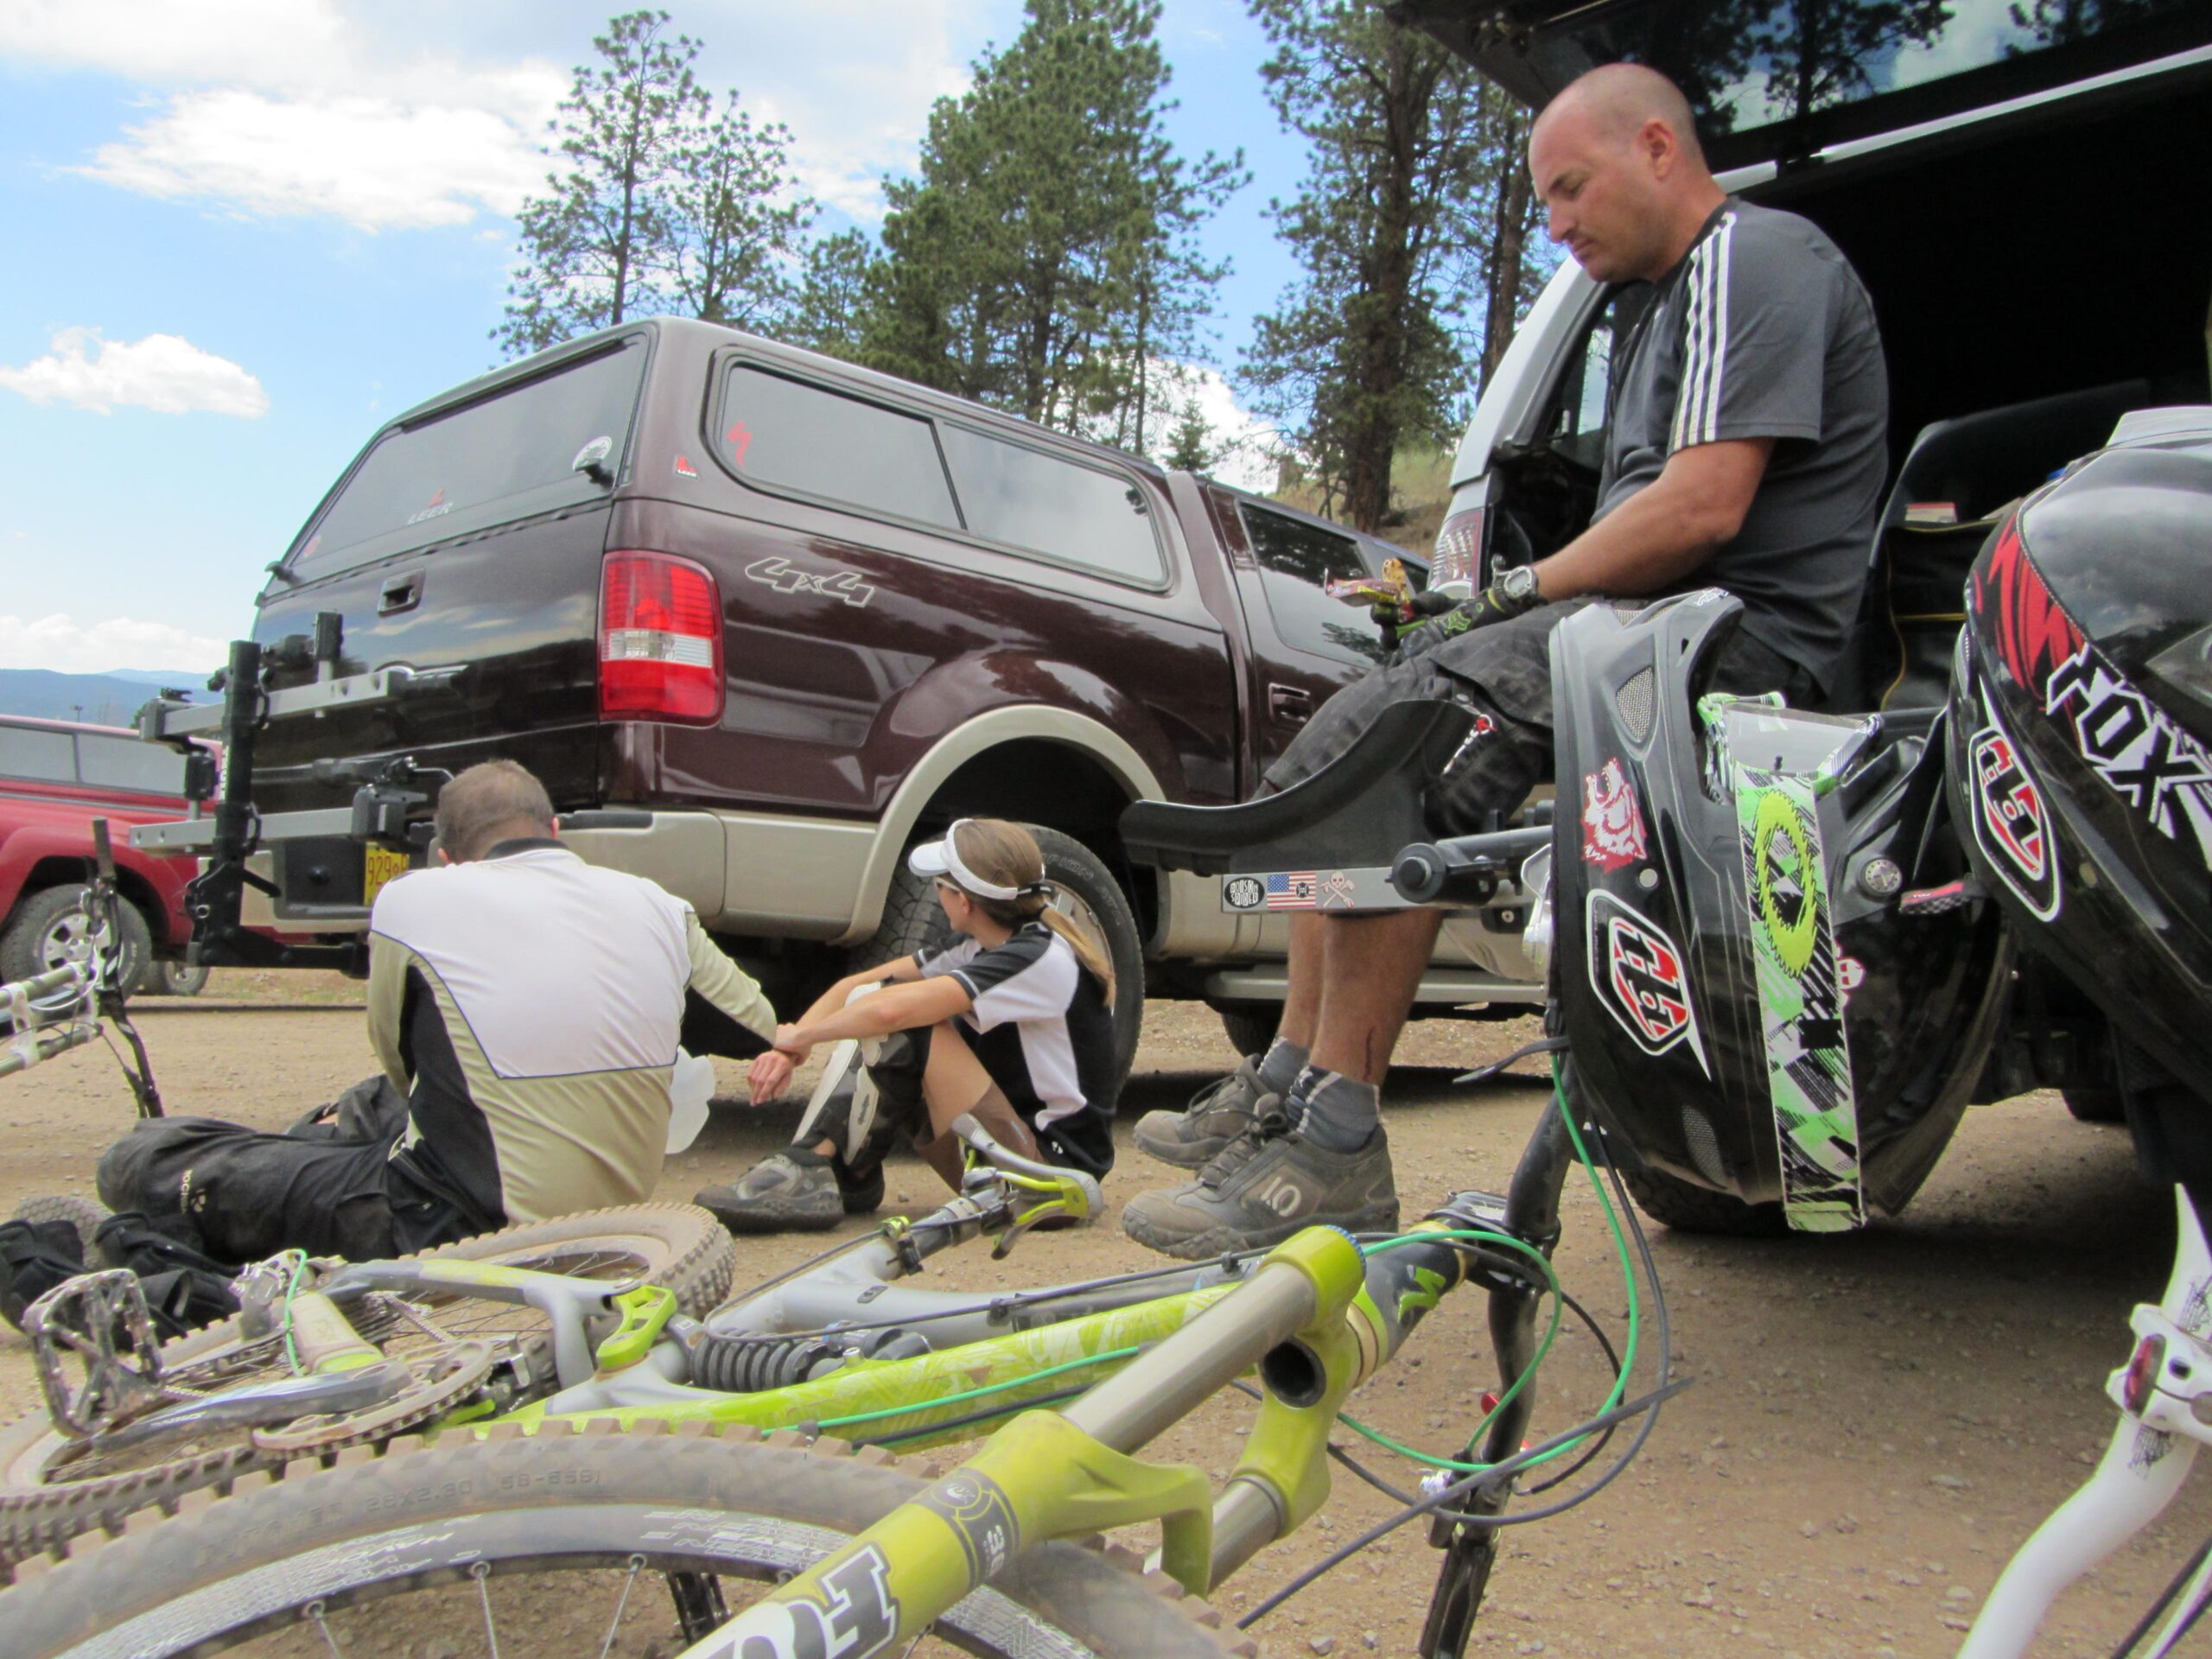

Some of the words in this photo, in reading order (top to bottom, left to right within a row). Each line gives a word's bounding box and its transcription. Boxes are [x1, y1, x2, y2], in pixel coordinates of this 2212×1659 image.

[2045, 640, 2210, 826] FOX
[1230, 880, 1258, 893] POISON
[1231, 892, 1259, 906] SPIDER
